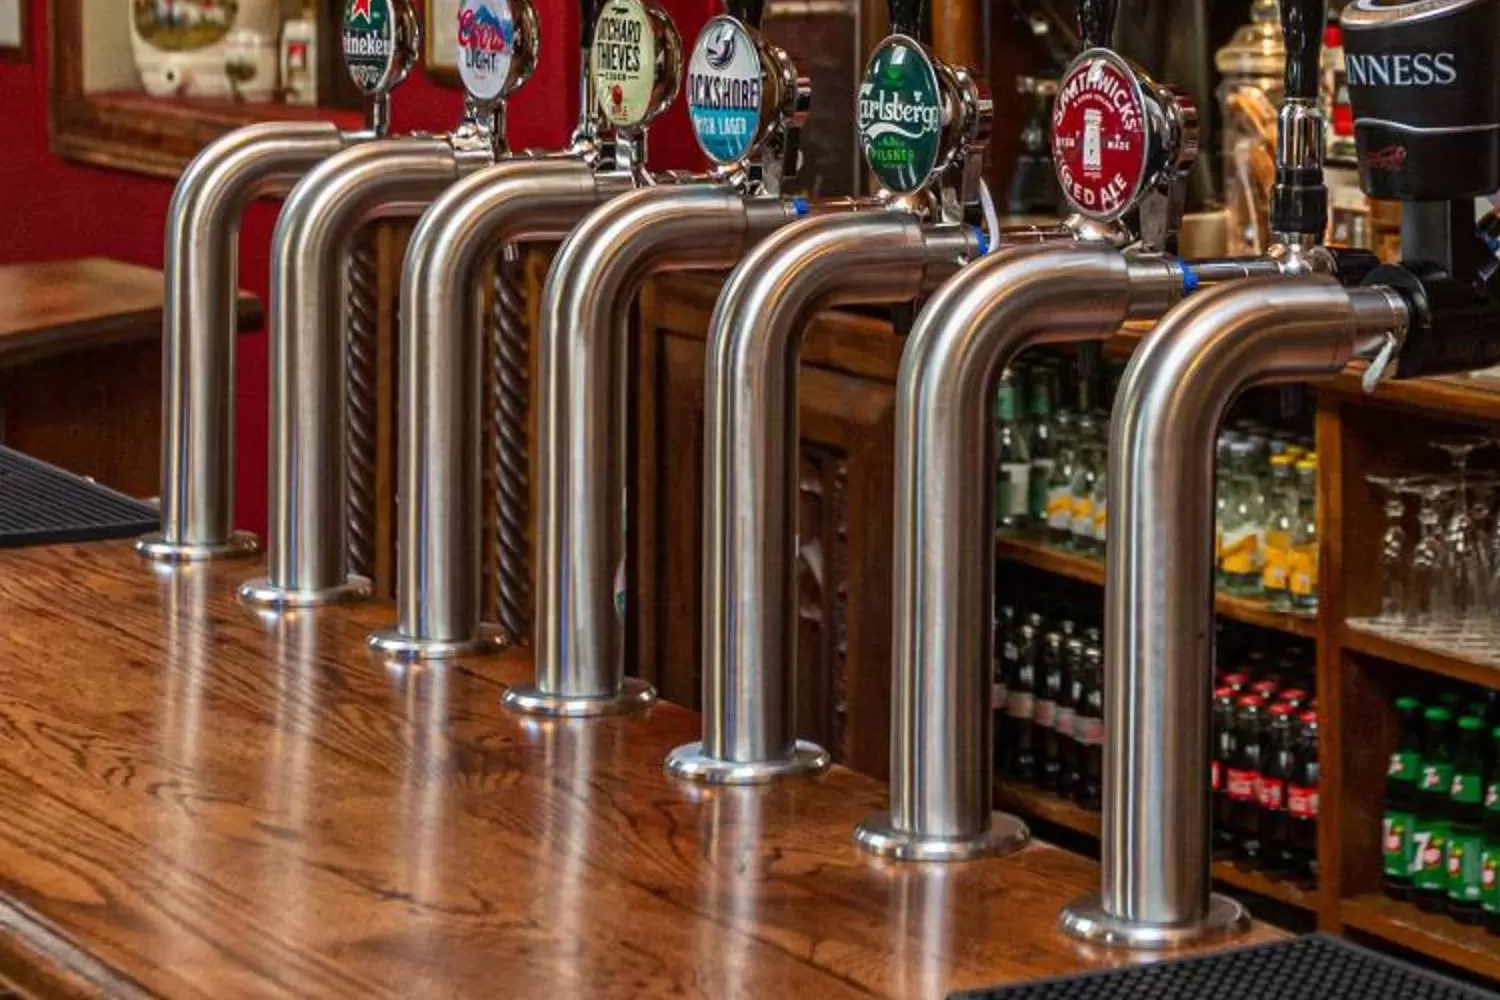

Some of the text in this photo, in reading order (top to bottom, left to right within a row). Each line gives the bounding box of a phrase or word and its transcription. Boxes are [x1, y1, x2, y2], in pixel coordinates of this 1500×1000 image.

[465, 48, 497, 73] LIGHT
[1346, 52, 1457, 86] INNESS
[689, 73, 759, 111] OCKSHORE
[857, 83, 938, 134] Carlsberg
[1100, 172, 1128, 207] ALE
